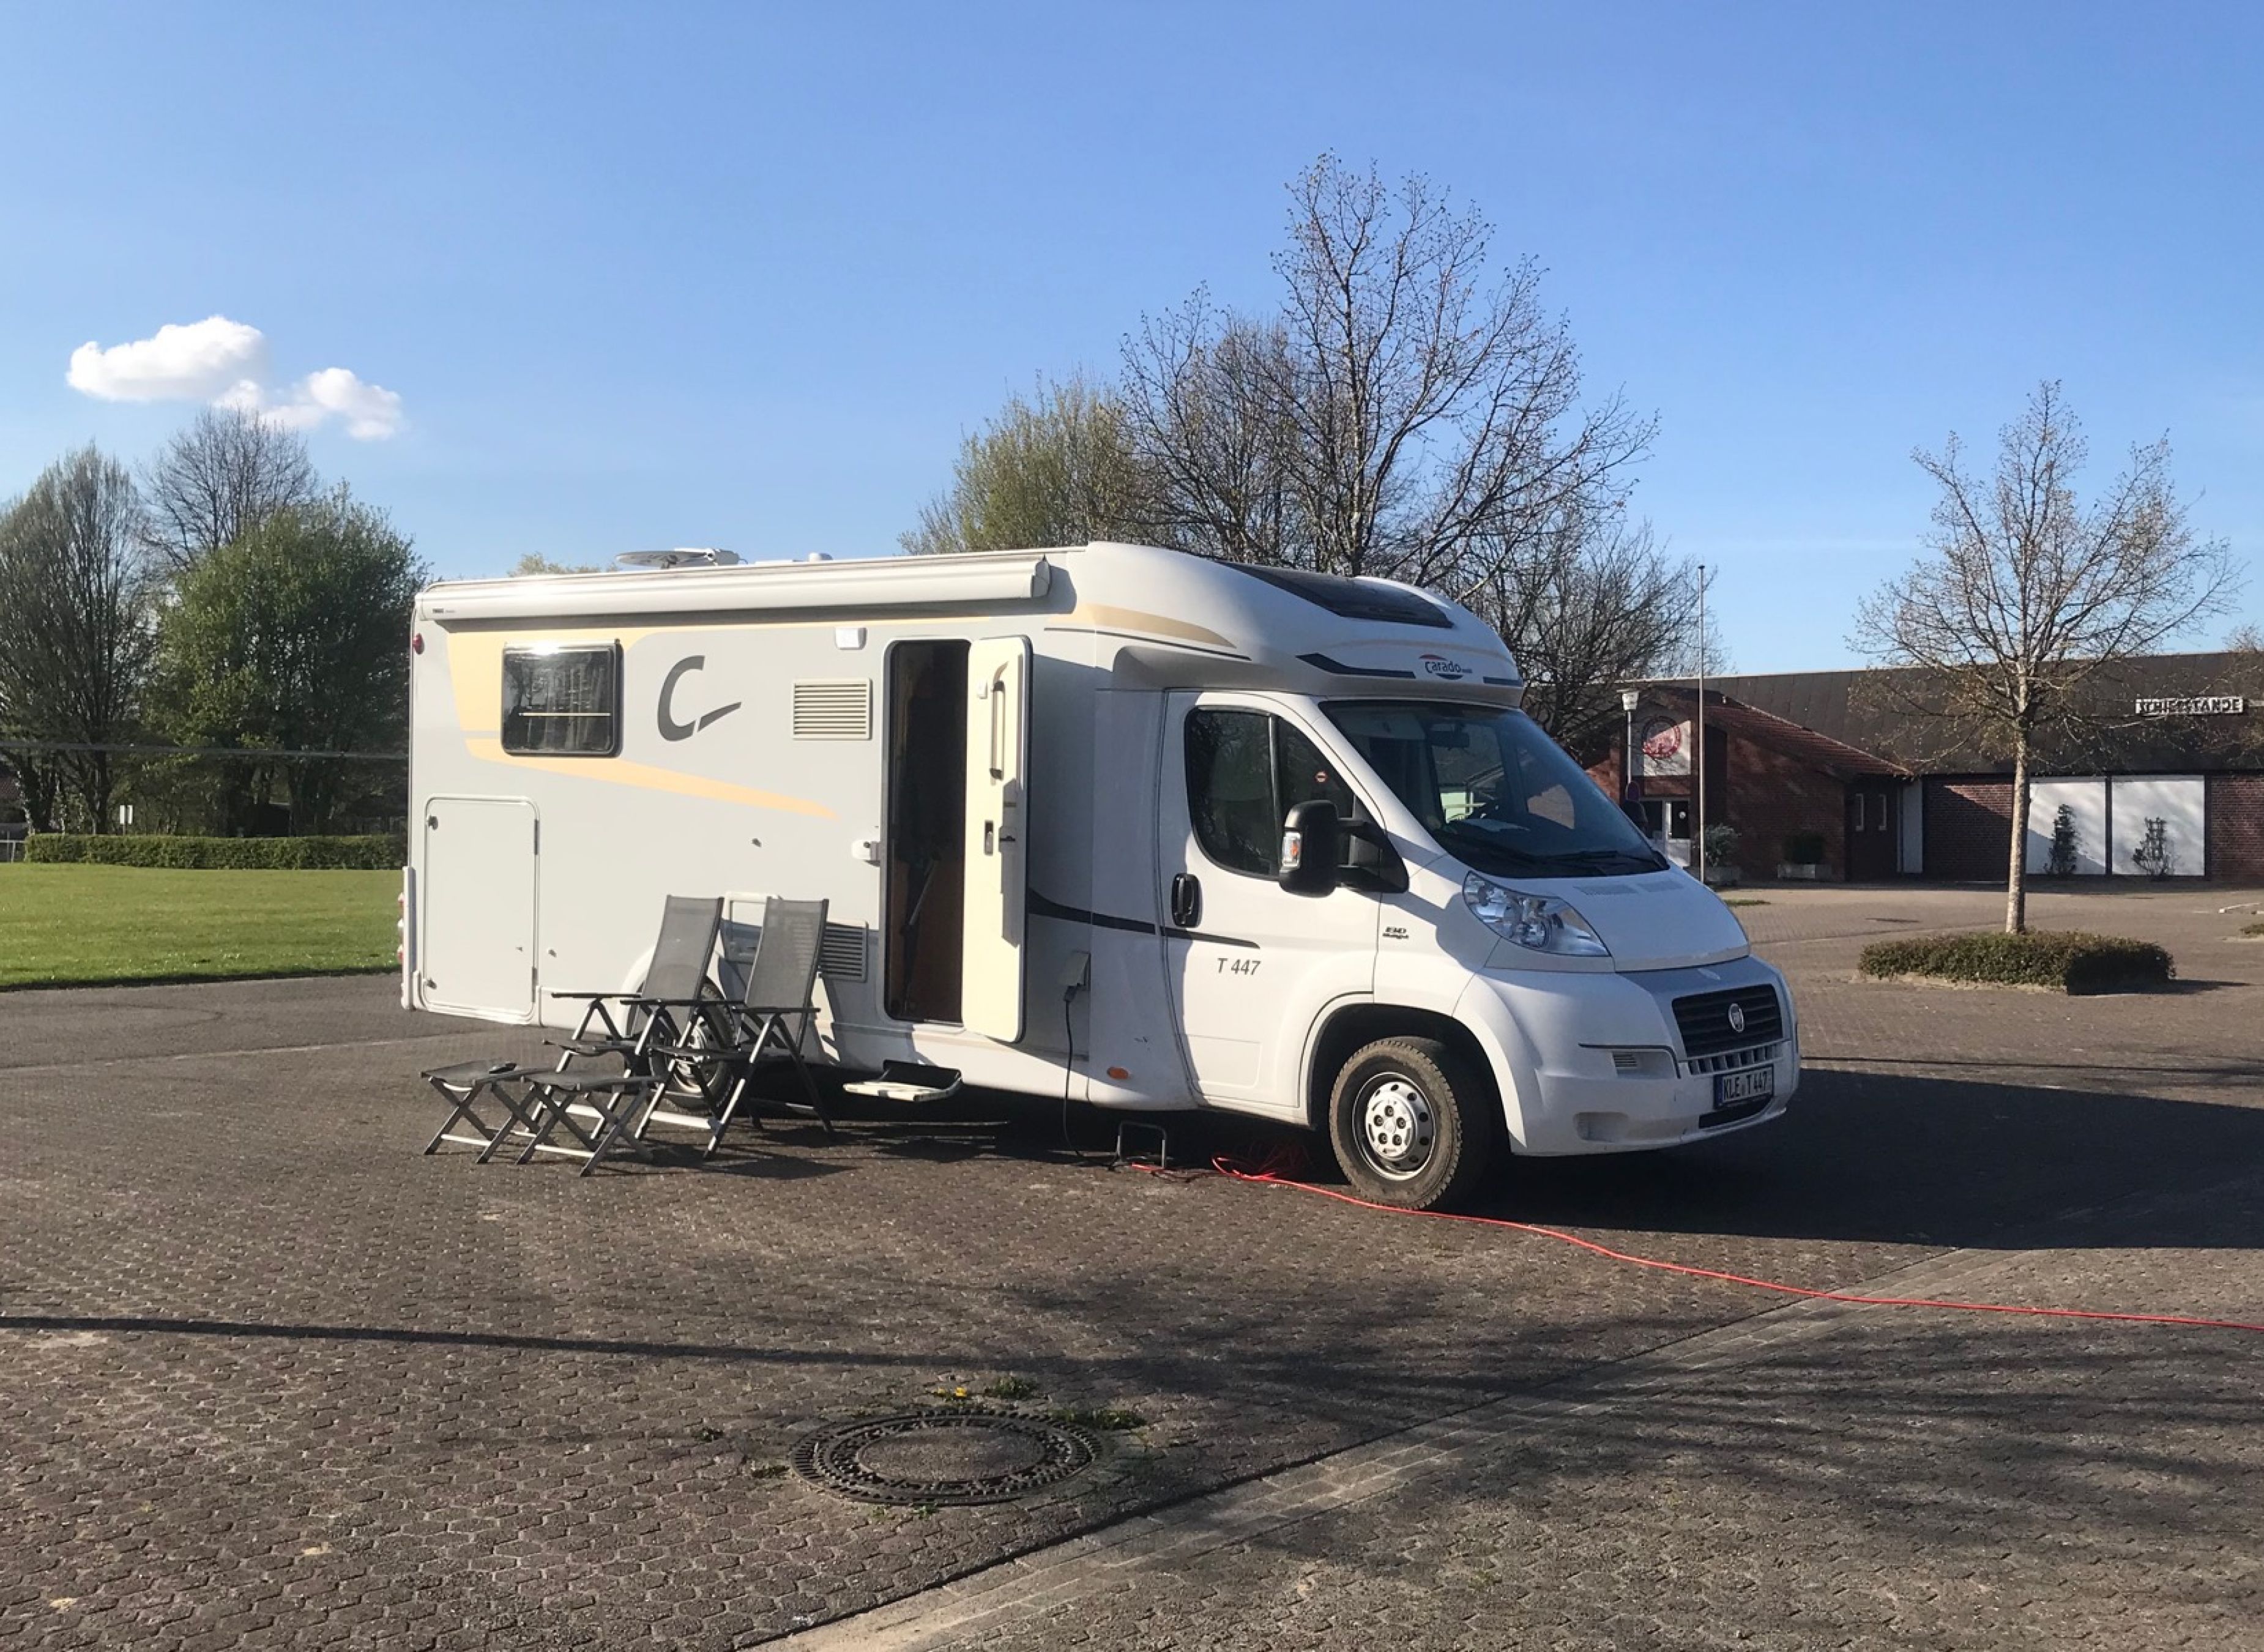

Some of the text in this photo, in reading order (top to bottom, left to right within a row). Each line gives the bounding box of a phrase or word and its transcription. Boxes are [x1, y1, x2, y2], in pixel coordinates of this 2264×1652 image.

[1425, 661, 1462, 674] Carado
[1217, 958, 1262, 975] T 447
